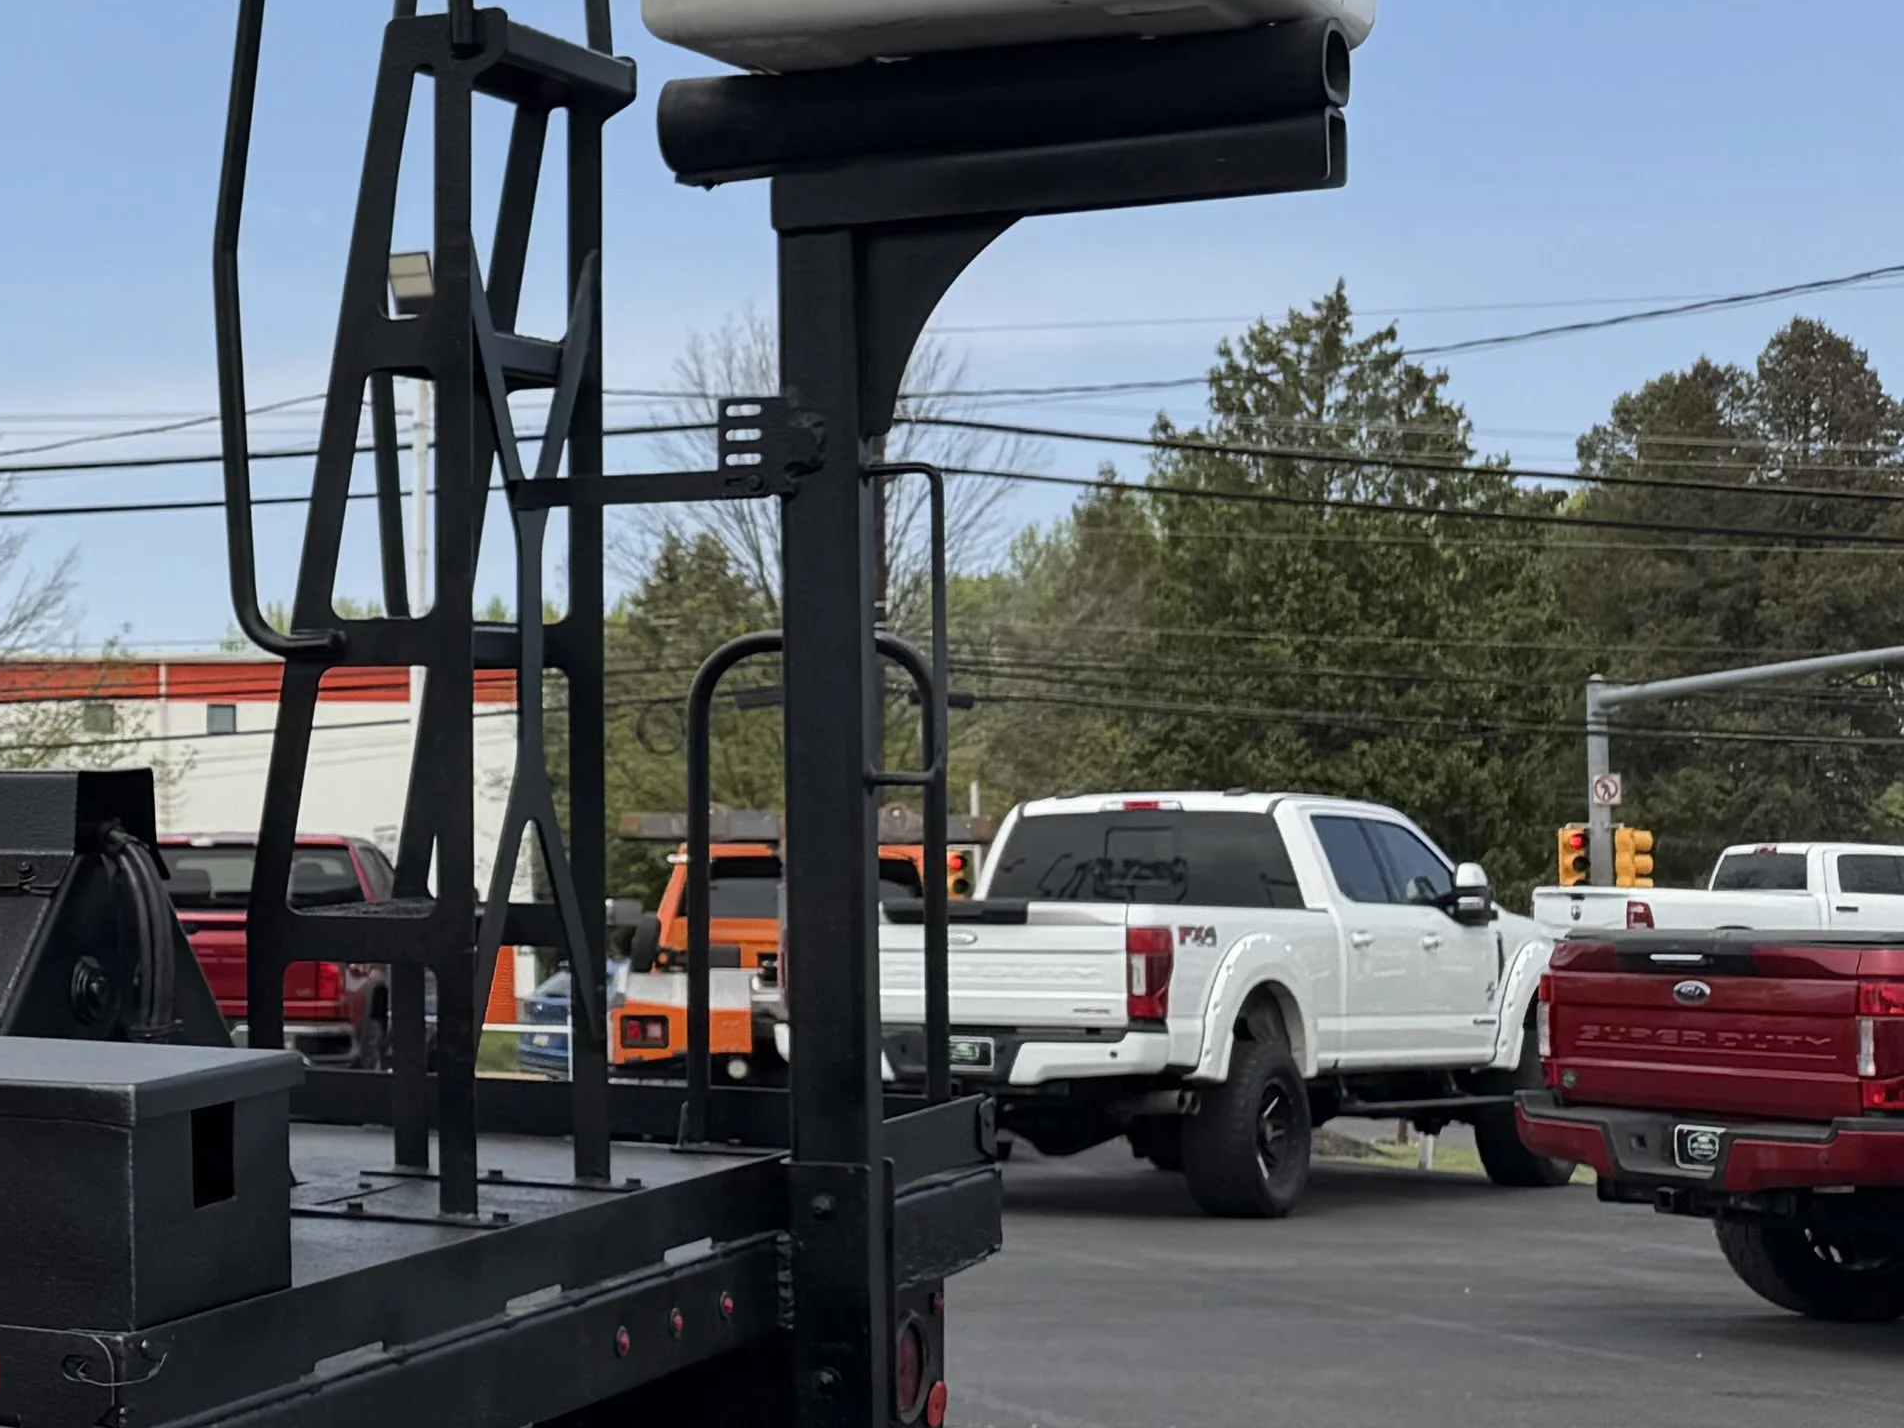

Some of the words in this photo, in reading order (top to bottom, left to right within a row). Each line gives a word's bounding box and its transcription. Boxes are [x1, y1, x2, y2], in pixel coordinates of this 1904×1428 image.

[1177, 925, 1218, 948] FX4
[1578, 1023, 1706, 1046] SUPER
[1717, 1031, 1832, 1049] DUTY
